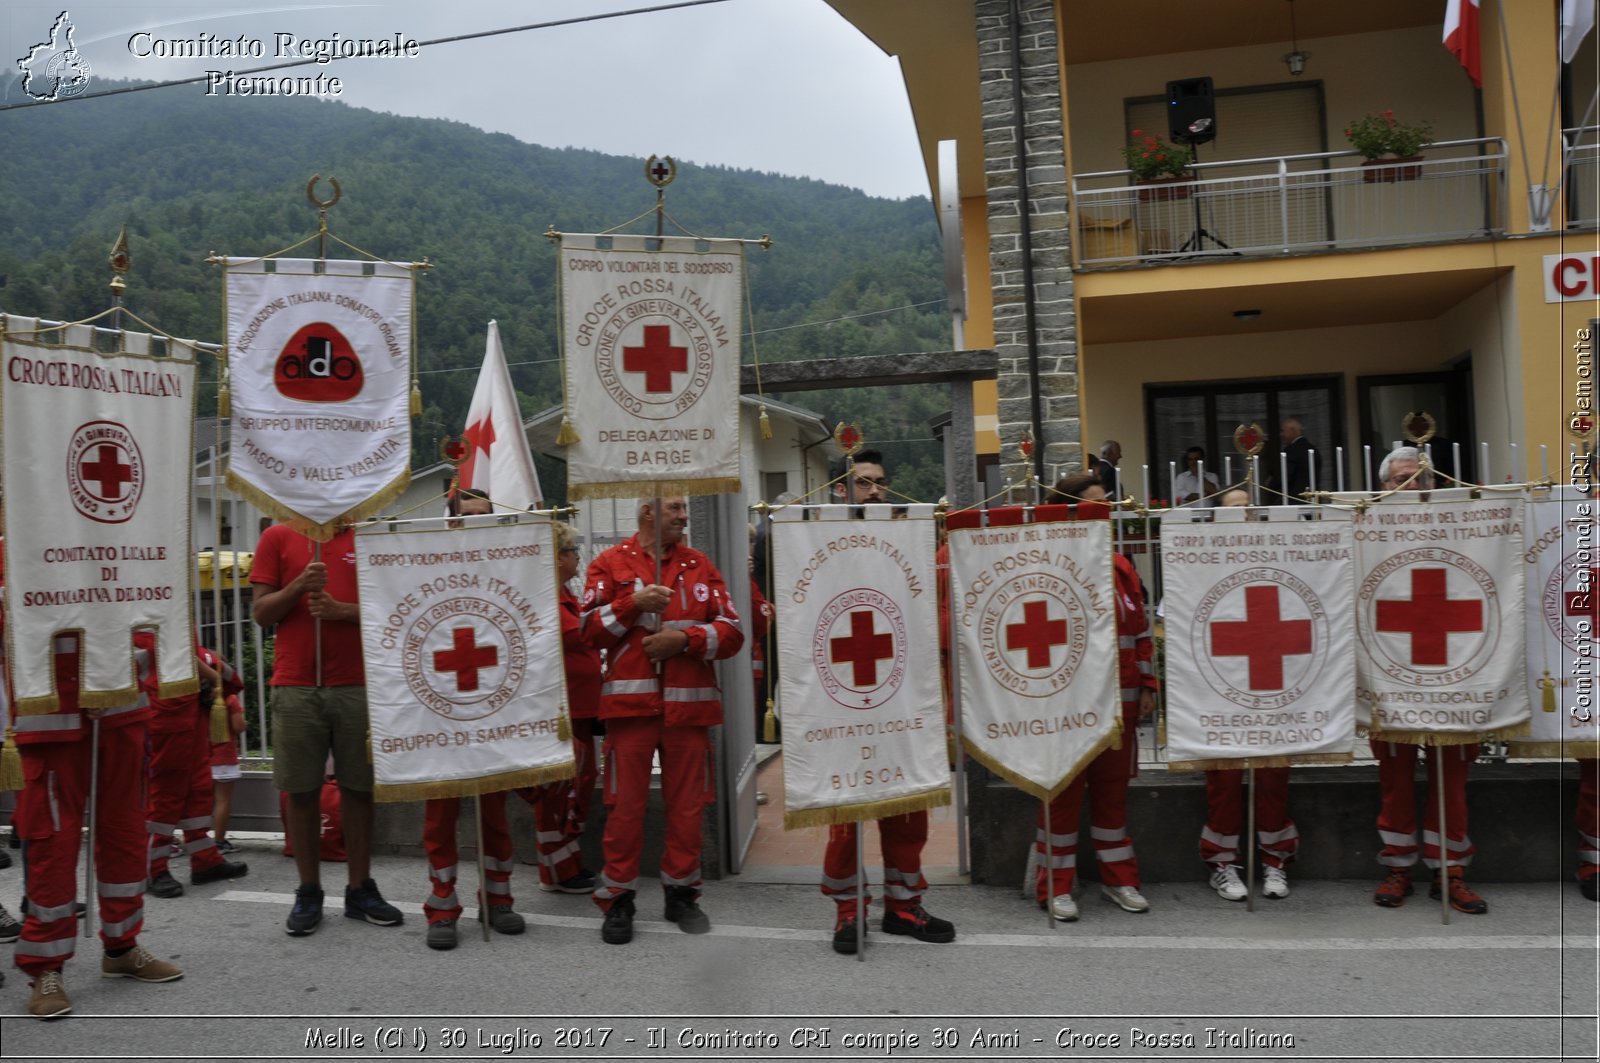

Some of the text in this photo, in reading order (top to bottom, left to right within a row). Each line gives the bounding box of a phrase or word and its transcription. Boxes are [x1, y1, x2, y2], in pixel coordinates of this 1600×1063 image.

[569, 258, 734, 274] CORPO VOLONTARI DEL SOCCORSO
[576, 278, 729, 348] CROCE ROSSA ITALIANA
[625, 301, 681, 319] GINEVRA
[236, 291, 402, 358] ASSOCIAZIONE ITALIANA DONATORI ORGANI
[612, 315, 626, 330] DI
[682, 315, 699, 332] 22
[282, 336, 357, 381] aido
[694, 336, 712, 388] AGOSTO
[8, 356, 69, 387] CROCE
[121, 368, 183, 398] ITALIANA
[599, 330, 643, 413] CONVENZIONE
[239, 416, 396, 432] GRUPPO INTERCOMUNALE
[599, 428, 715, 442] DELEGAZIONE DI
[242, 438, 401, 481] PIASCO e VALLE VARAITA
[626, 449, 691, 465] BARGE
[1378, 512, 1433, 525] VOLONTARI
[1438, 512, 1458, 524] DEL
[1462, 507, 1513, 522] SOCCORSO
[1024, 531, 1042, 542] DEL
[1269, 534, 1287, 546] DEL
[1393, 529, 1448, 542] ROSSA
[1454, 523, 1522, 540] ITALIANA
[1524, 525, 1564, 564] CROCE
[368, 553, 404, 567] CORPO
[408, 552, 464, 566] VOLONTARI
[466, 550, 484, 562] DEL
[487, 544, 541, 559] SOCCORSO
[1165, 549, 1351, 564] CROCE ROSSA ITALIANA
[101, 567, 119, 581] DI
[793, 534, 924, 604] CROCE ROSSA ITALIANA
[1359, 549, 1435, 600] CONVENZIONE
[1440, 551, 1453, 562] DI
[993, 549, 1051, 577] ROSSA
[1055, 552, 1108, 620] ITALIANA
[1013, 576, 1067, 596] GINEVRA
[997, 591, 1011, 605] DI
[1195, 569, 1324, 623] CONVENZIONE DI GINEVRA
[380, 573, 545, 650] CROCE ROSSA ITALIANA
[404, 600, 524, 714] CONVENZIONE DI GINEVRA 22 AGOSTO 1864
[982, 607, 1029, 693] CONVENZIONE
[1430, 690, 1494, 703] LOCALE
[986, 712, 1098, 740] SAVIGLIANO
[1200, 710, 1330, 728] DELEGAZIONE DI
[1376, 709, 1492, 725] RACCONIGI
[381, 719, 559, 754] GRUPPO DI SAMPEYRE
[805, 717, 924, 742] COMITATO LOCALE
[1205, 727, 1324, 746] PEVERAGNO
[860, 744, 877, 760] DI
[831, 766, 905, 790] BUSCA
